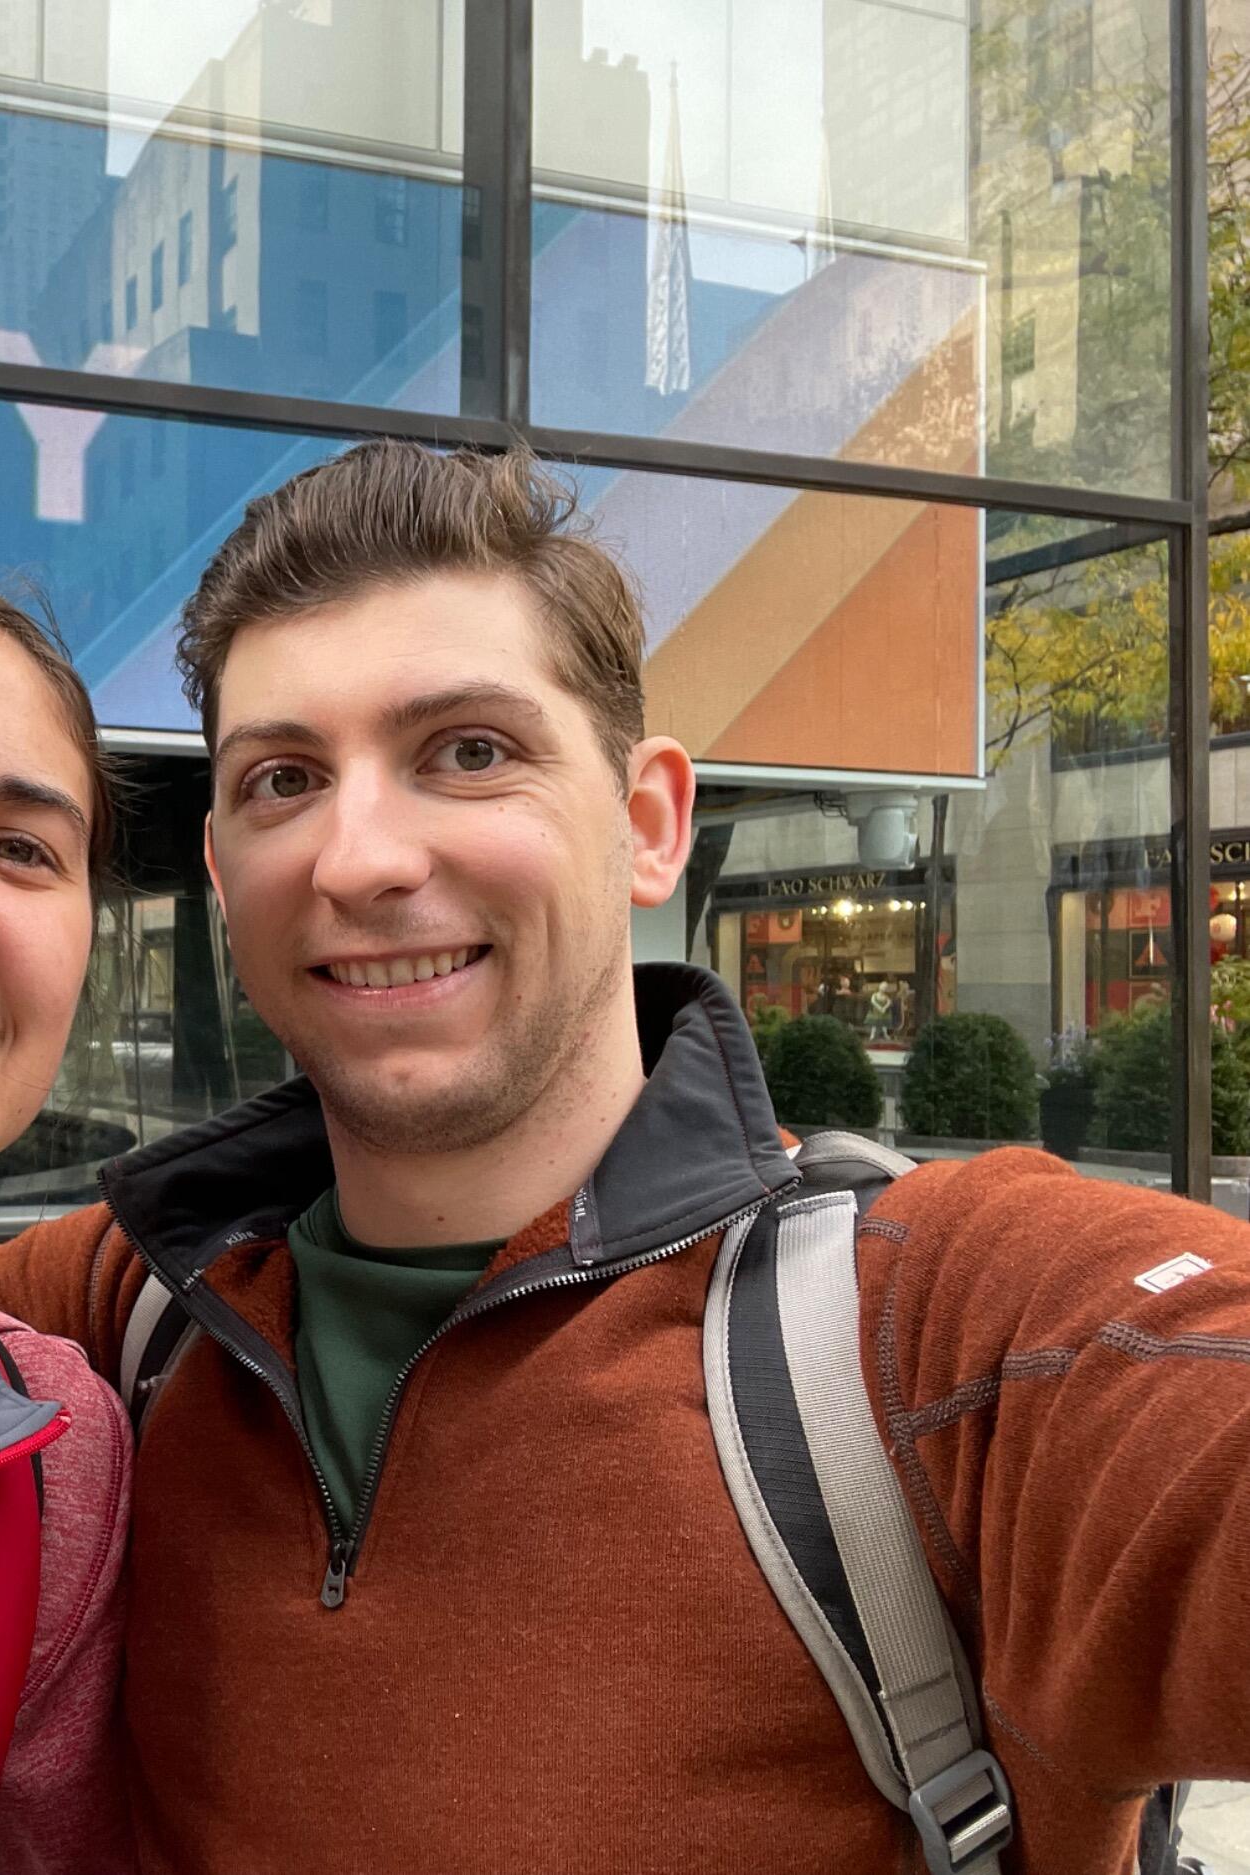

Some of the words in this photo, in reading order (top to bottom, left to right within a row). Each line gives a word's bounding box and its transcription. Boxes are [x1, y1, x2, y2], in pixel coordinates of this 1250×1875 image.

[1144, 848, 1171, 870] FA
[1210, 841, 1250, 865] SC
[767, 879, 803, 896] FAO
[808, 872, 886, 893] SCHWARZ
